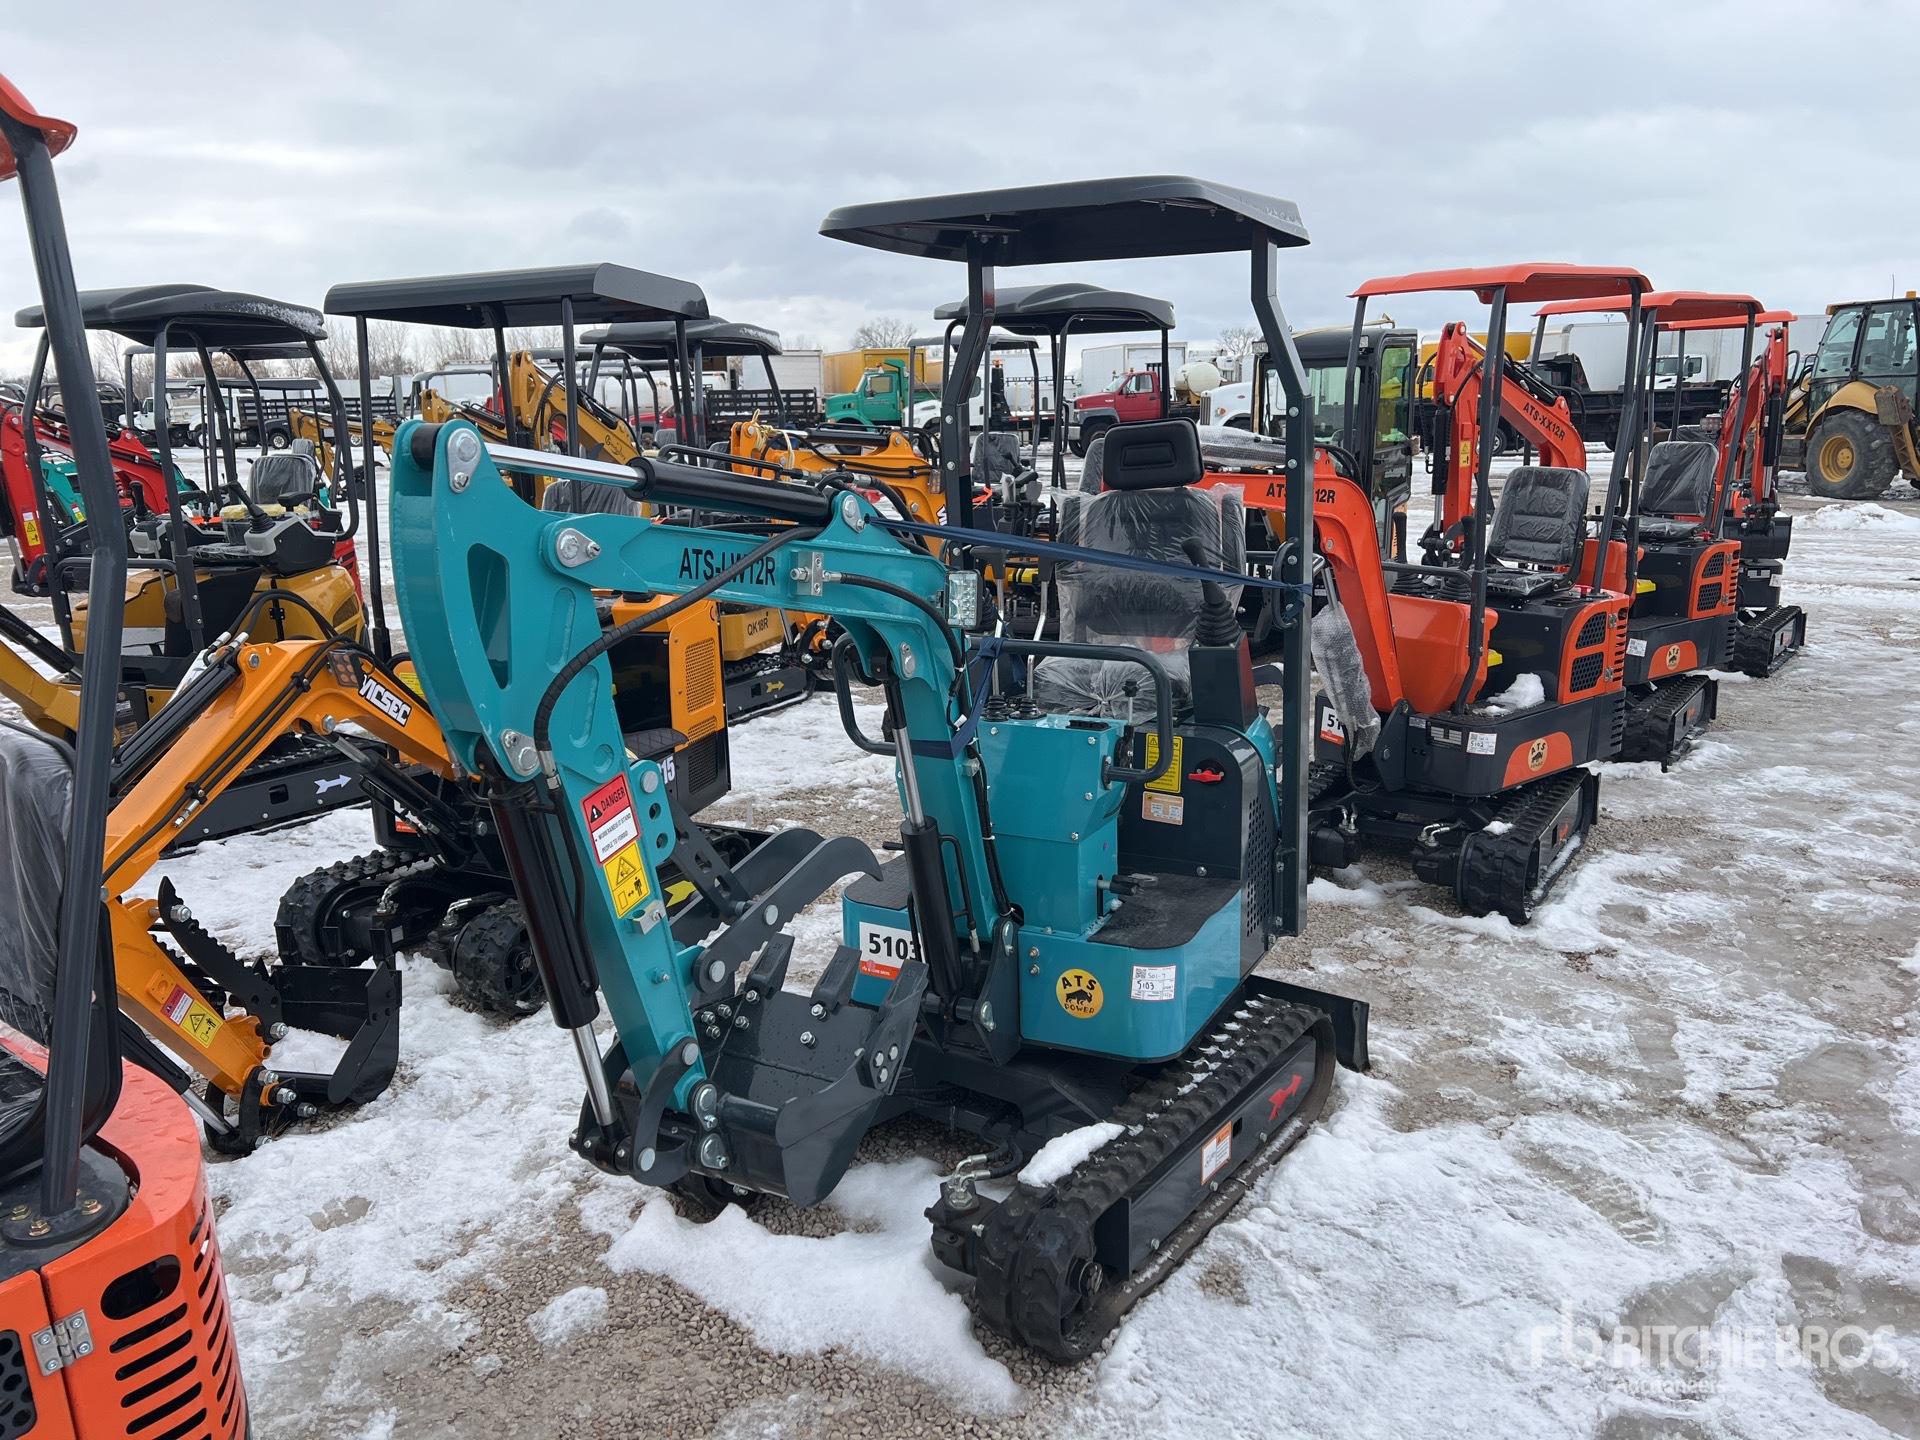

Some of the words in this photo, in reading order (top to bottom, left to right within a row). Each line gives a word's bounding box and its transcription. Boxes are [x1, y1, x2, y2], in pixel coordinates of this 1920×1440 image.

[359, 674, 411, 726] VICSEC
[1531, 742, 1546, 755] ATS
[600, 786, 626, 811] DANGER
[1061, 975, 1097, 991] ATS
[1137, 980, 1155, 990] 5103
[1064, 1003, 1095, 1014] POWER
